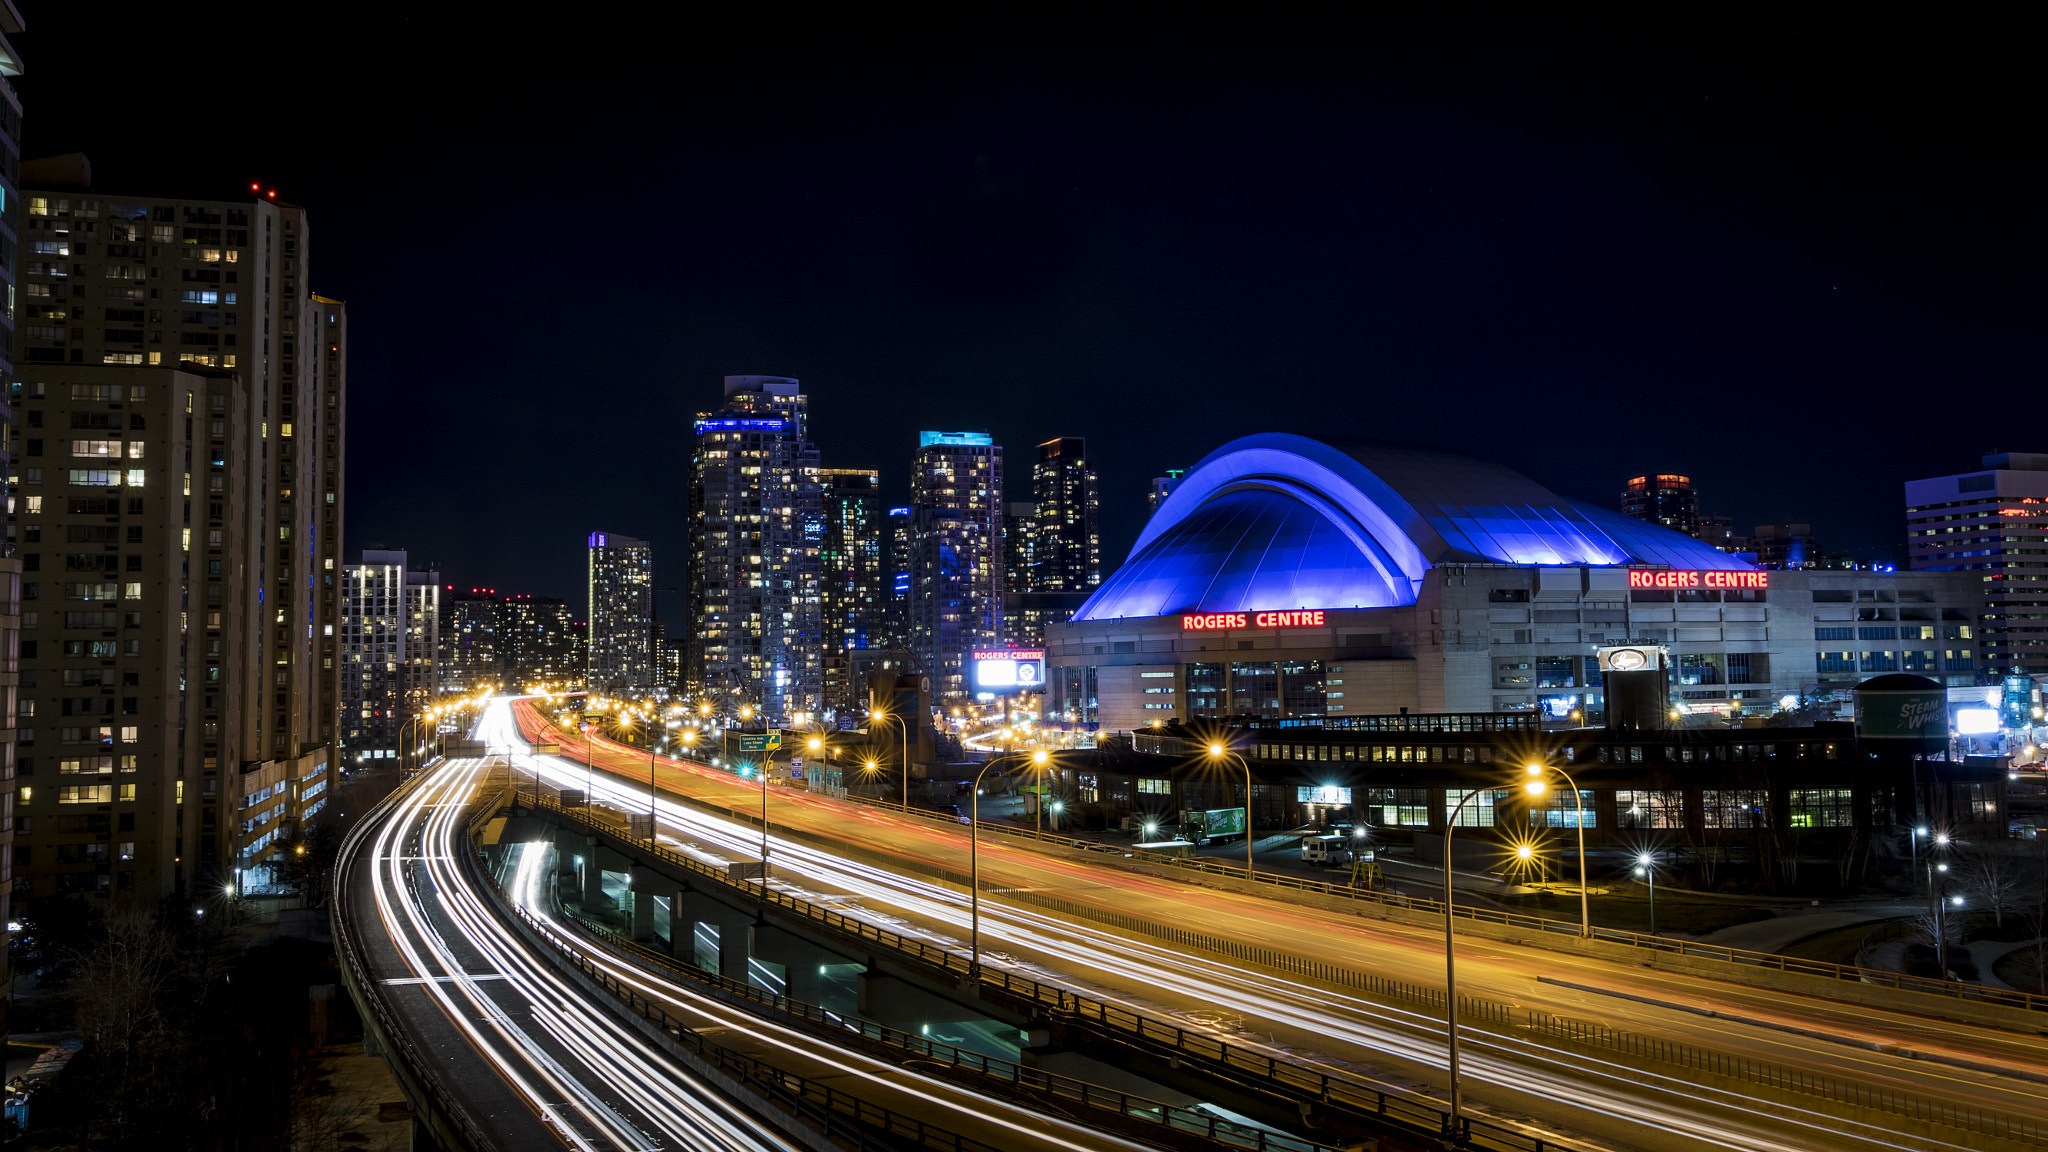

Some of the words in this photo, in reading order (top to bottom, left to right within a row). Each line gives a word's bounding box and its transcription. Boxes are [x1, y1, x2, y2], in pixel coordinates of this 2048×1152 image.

[1630, 571, 1699, 587] ROGERS
[1703, 571, 1768, 587] CENTRE
[1183, 613, 1247, 630] ROGERS
[1256, 611, 1325, 627] CENTRE
[974, 652, 1009, 660] ROGERS
[1010, 651, 1043, 659] CENTRE
[1900, 699, 1939, 718] STEAM
